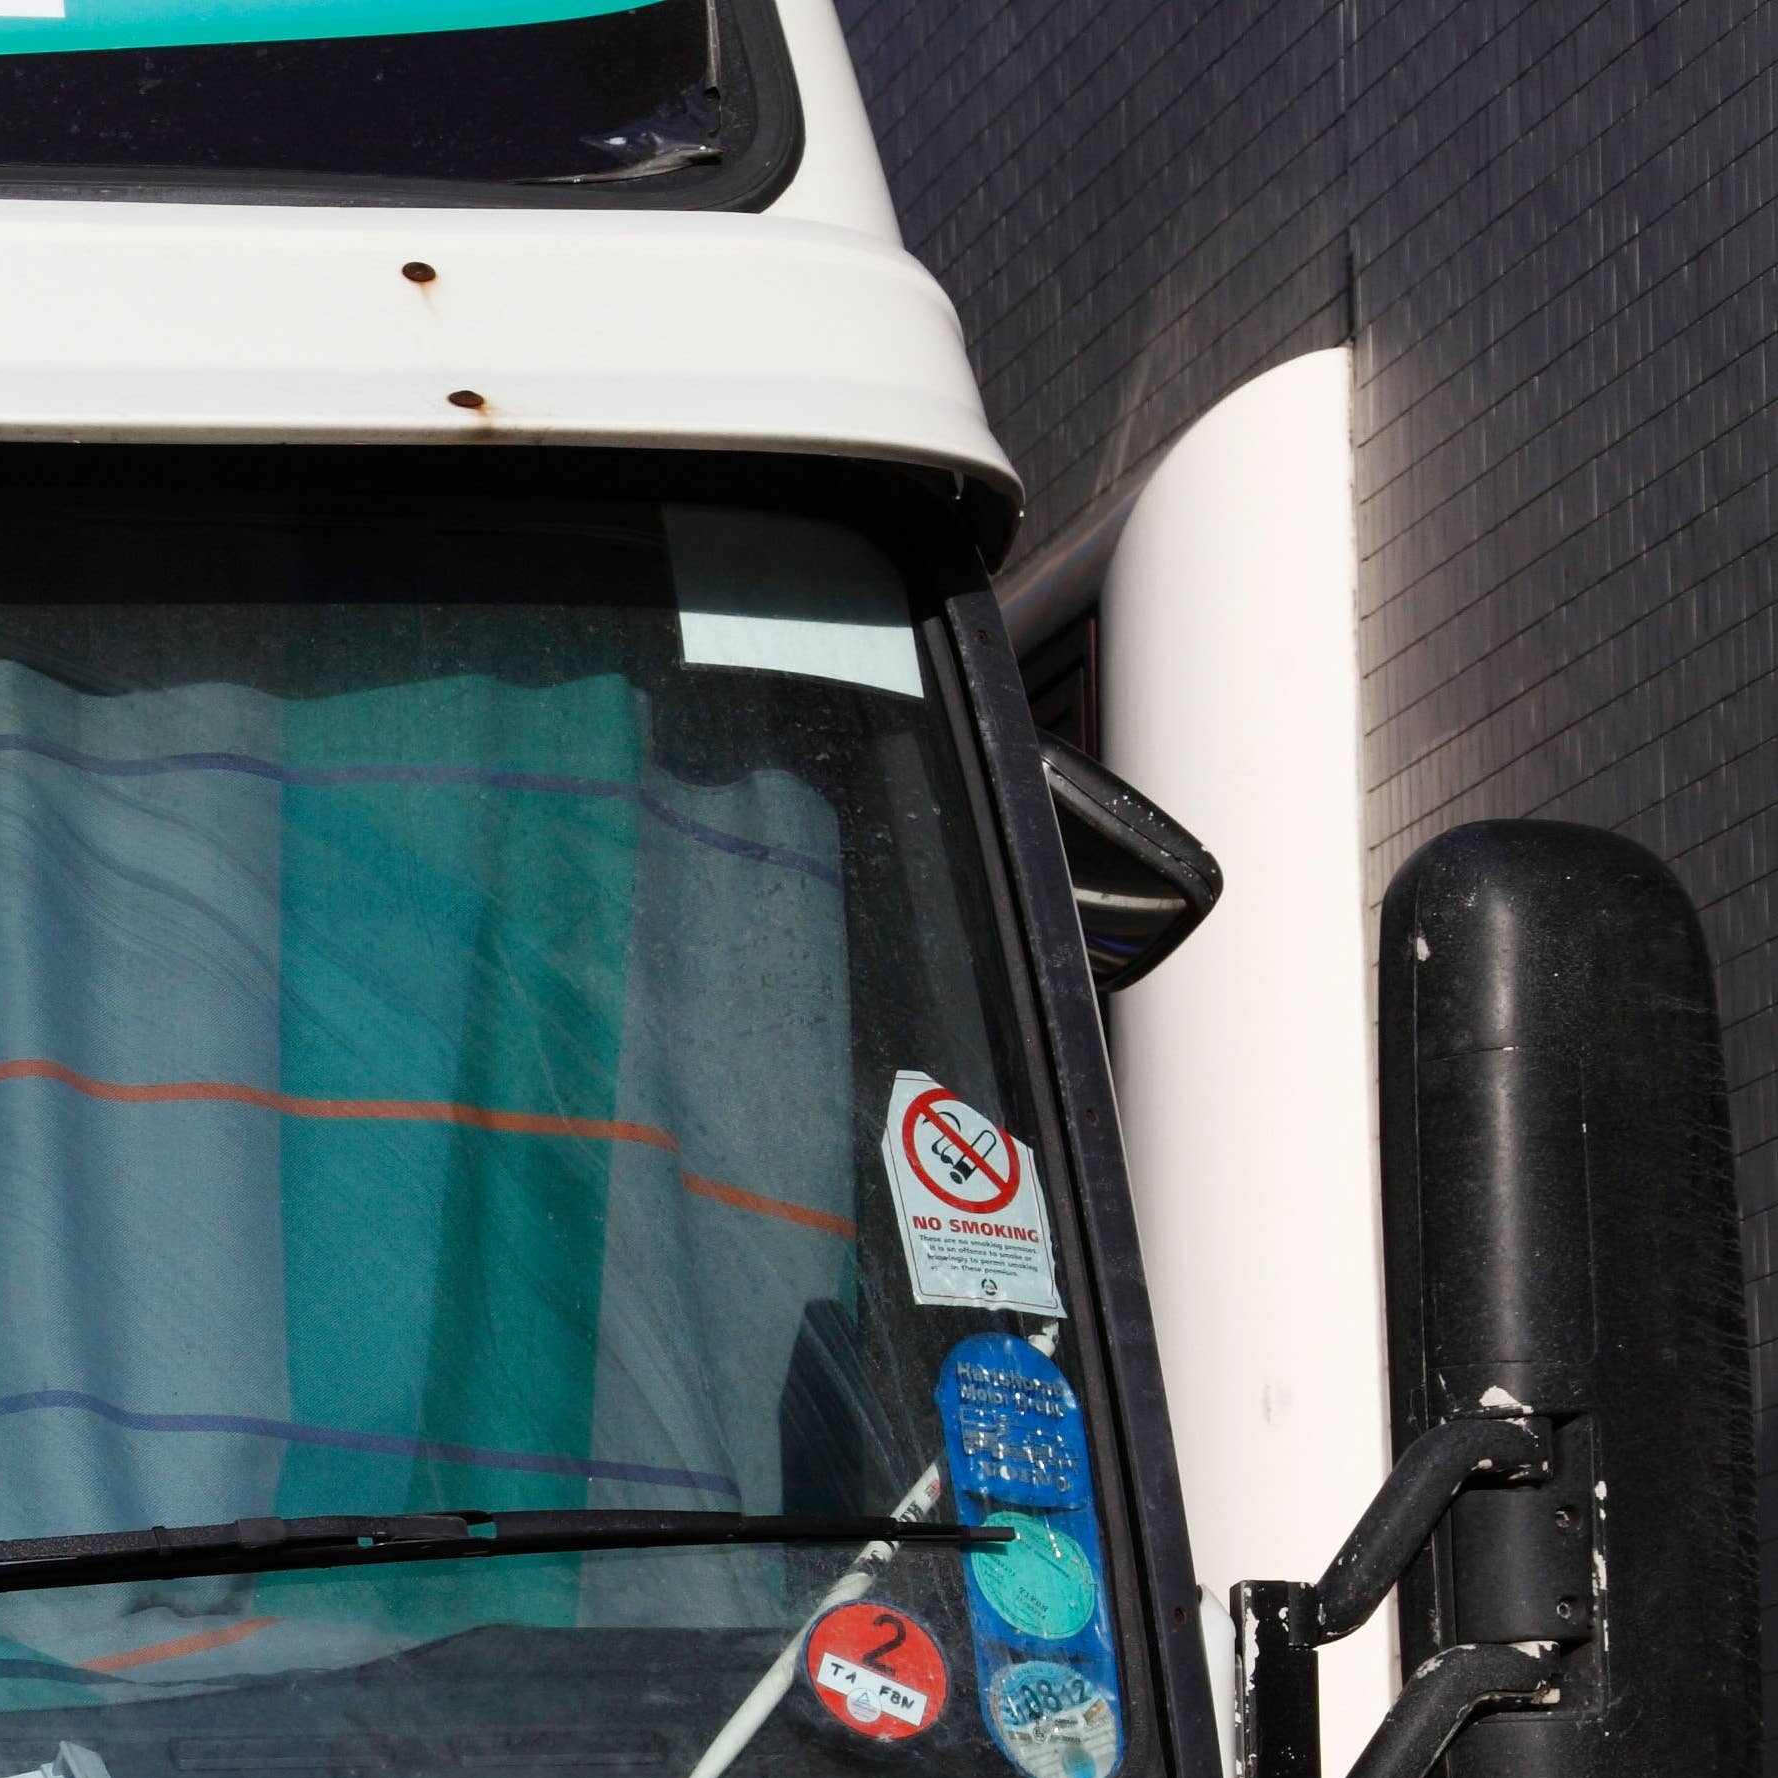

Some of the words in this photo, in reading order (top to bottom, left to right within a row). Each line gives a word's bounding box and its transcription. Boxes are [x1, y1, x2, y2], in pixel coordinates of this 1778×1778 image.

[912, 1215, 942, 1231] NO
[949, 1219, 1039, 1244] SMOKING
[970, 1240, 1003, 1251] smoking
[958, 1247, 987, 1256] offence
[999, 1252, 1023, 1260] smoke
[980, 1258, 1005, 1268] permit
[1008, 1261, 1038, 1273] smoking
[862, 1613, 907, 1676] 2
